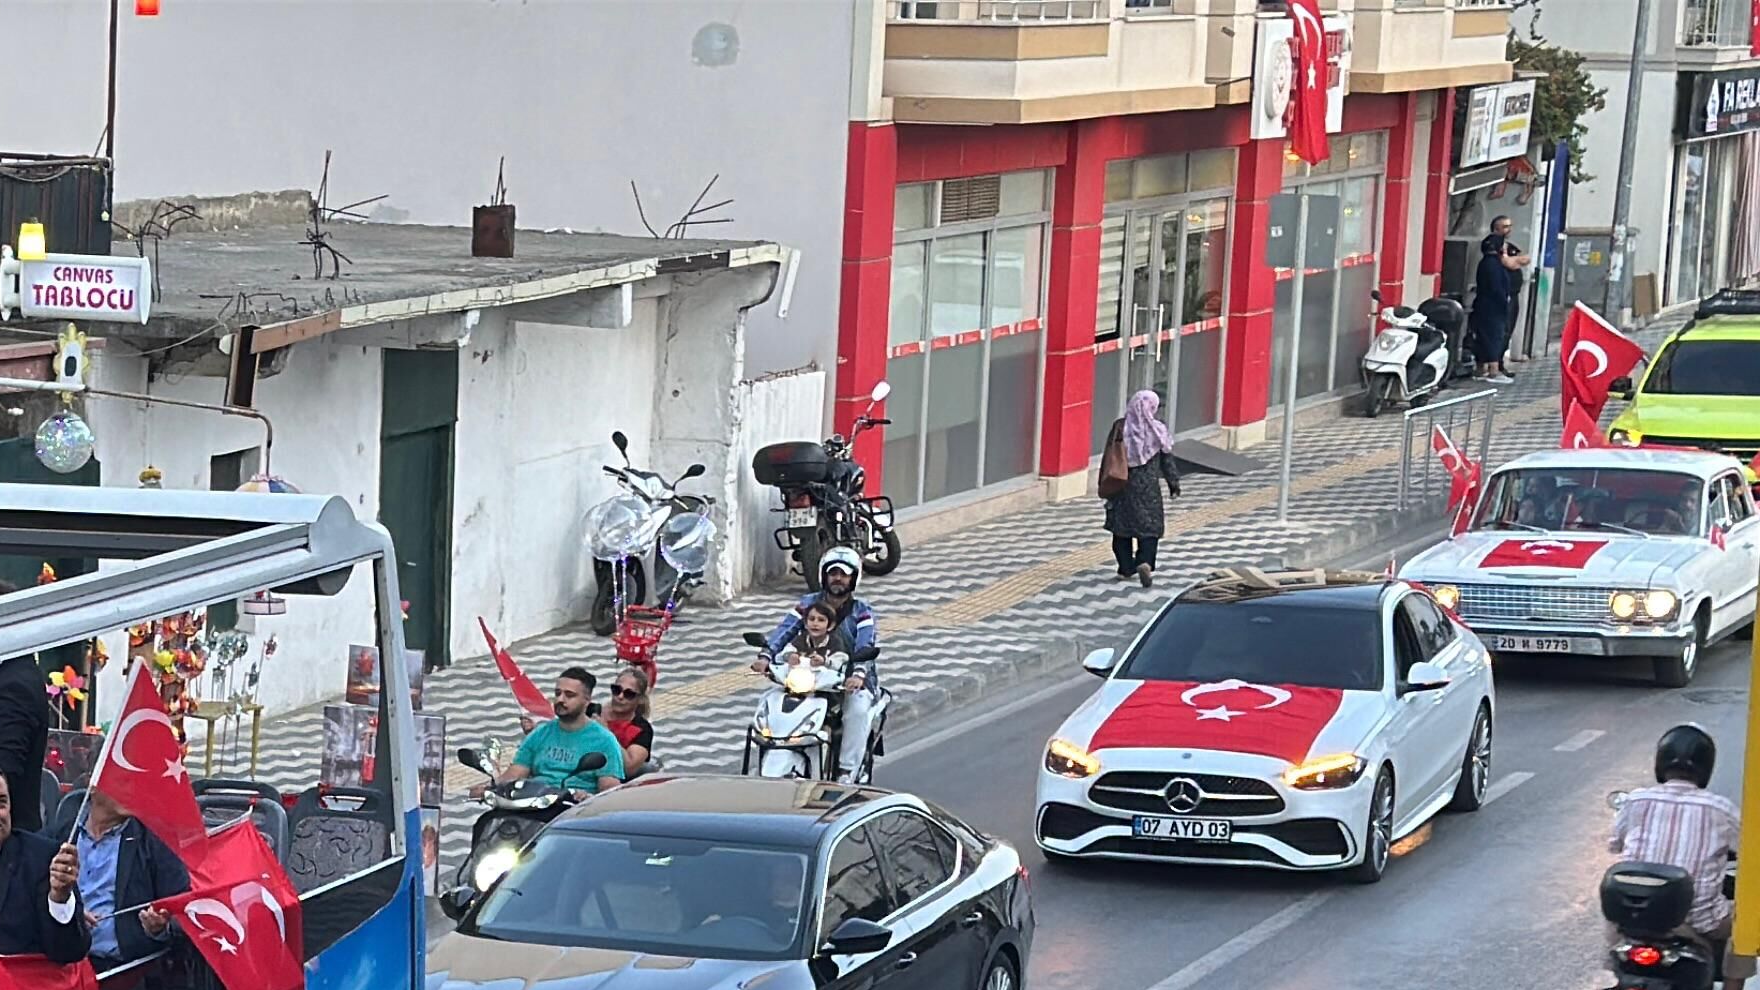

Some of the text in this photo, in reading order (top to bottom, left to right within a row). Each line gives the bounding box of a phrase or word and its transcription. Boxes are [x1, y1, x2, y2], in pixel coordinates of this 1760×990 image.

[53, 266, 113, 284] CANVAS
[1142, 819, 1228, 837] 07 AYD 03
